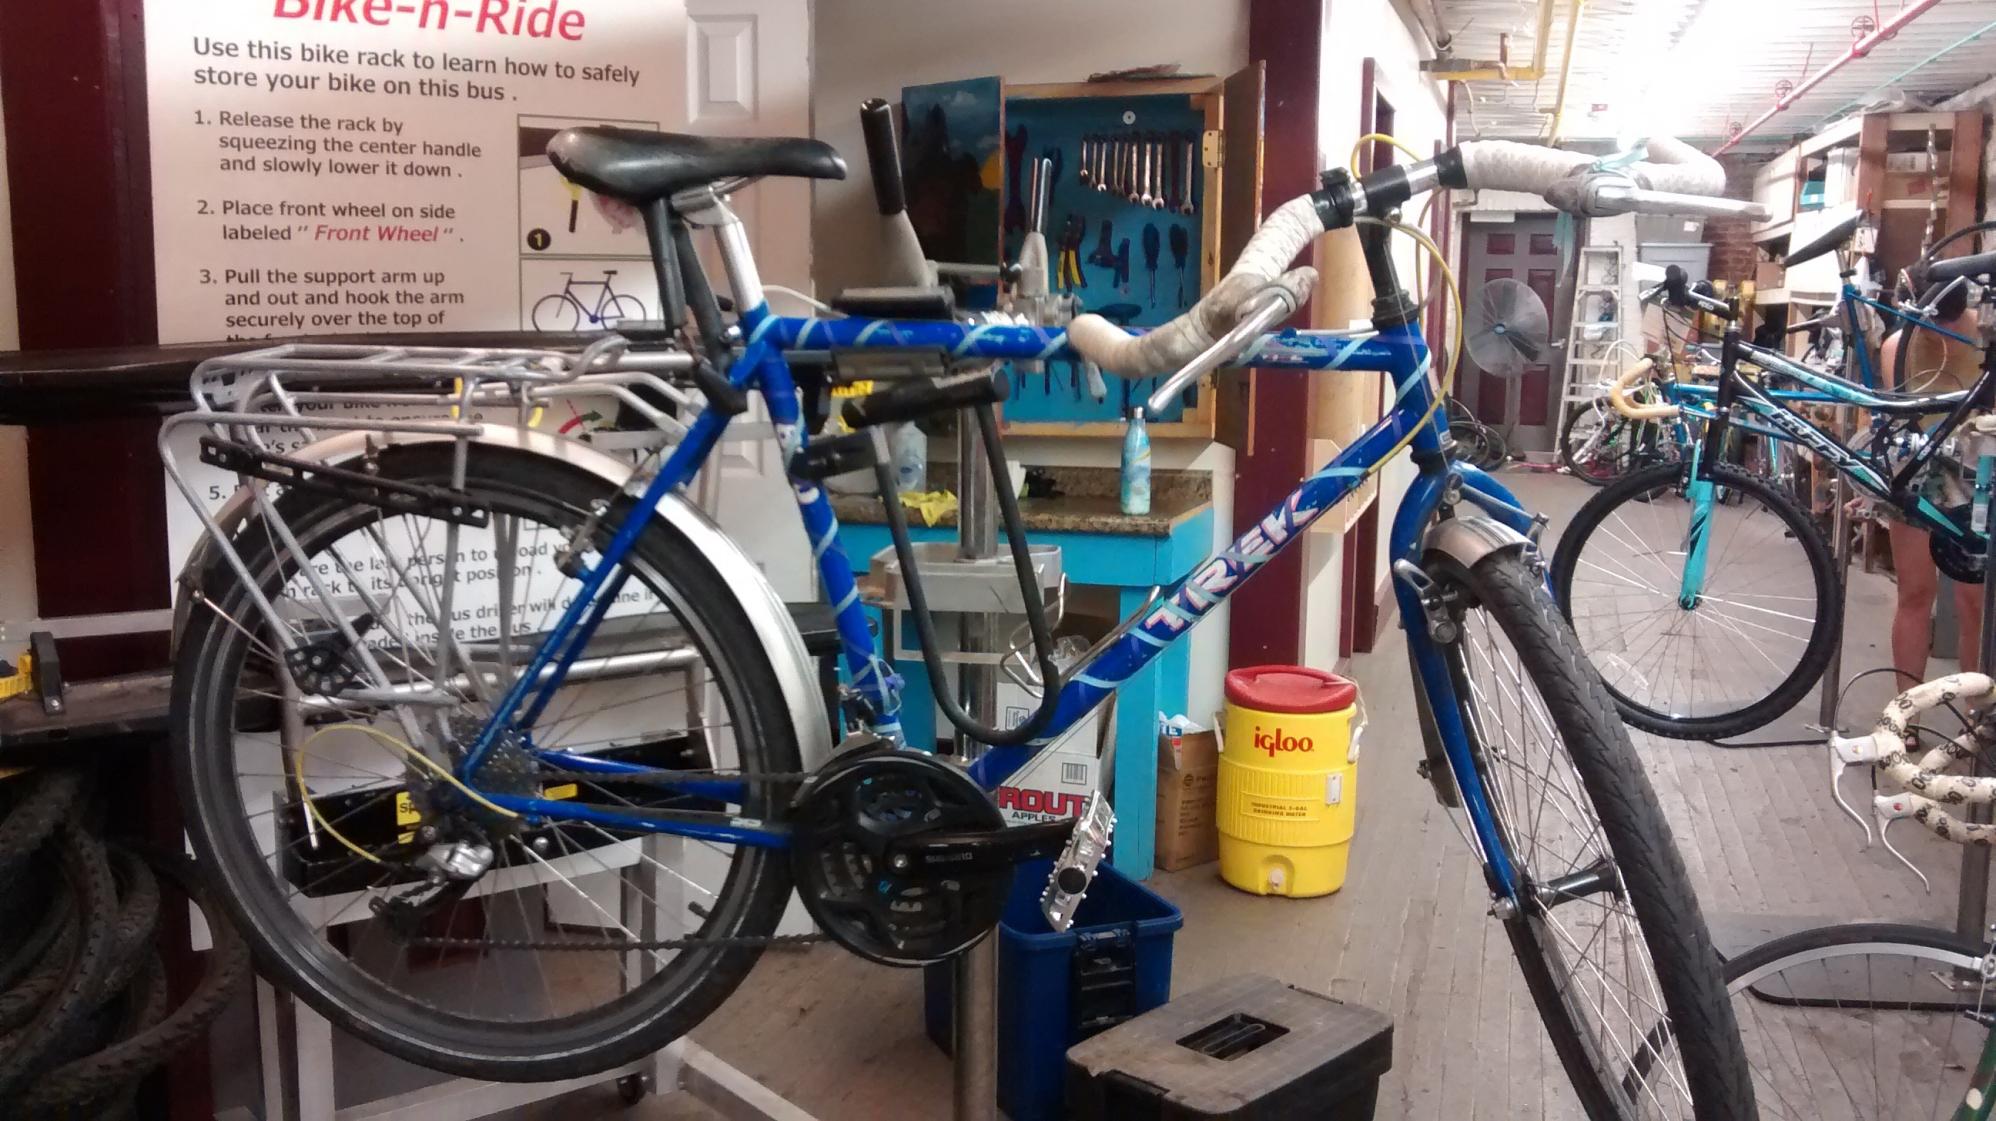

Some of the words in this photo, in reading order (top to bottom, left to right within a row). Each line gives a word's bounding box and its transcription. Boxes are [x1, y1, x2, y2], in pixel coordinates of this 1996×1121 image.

[193, 37, 239, 57] Use
[247, 40, 292, 61] this
[301, 43, 349, 64] bike
[357, 49, 405, 68] rack
[413, 51, 435, 70] to
[442, 53, 496, 74] learn
[505, 57, 548, 77] how
[555, 61, 575, 80] to
[582, 64, 640, 87] safely
[194, 66, 258, 87] store
[265, 72, 320, 93] your
[329, 72, 376, 94] bike
[384, 78, 411, 95] on
[419, 78, 459, 98] this
[467, 81, 504, 101] bus
[194, 110, 212, 125] 1.
[220, 111, 294, 129] Release
[300, 113, 331, 130] the
[337, 116, 376, 132] rack
[382, 118, 403, 136] by
[219, 135, 317, 154] squeezing
[323, 137, 354, 153] the
[359, 140, 416, 155] center
[423, 141, 482, 158] handle
[220, 156, 256, 171] and
[263, 157, 322, 176] slowly
[329, 158, 379, 175] lower
[386, 160, 398, 176] it
[403, 160, 451, 177] down
[197, 200, 215, 215] 2.
[222, 200, 273, 216] Place
[280, 200, 326, 217] front
[332, 203, 386, 218] wheel
[391, 206, 414, 218] on
[420, 203, 456, 219] side
[222, 224, 292, 241] labeled
[314, 224, 371, 241] Front
[377, 225, 438, 242] Wheel
[199, 269, 218, 284] 3.
[225, 268, 260, 284] Pull
[267, 269, 297, 284] the
[304, 269, 375, 287] support
[381, 271, 416, 284] arm
[423, 272, 445, 287] up
[225, 290, 261, 306] and
[267, 292, 298, 306] out
[305, 290, 339, 305] and
[345, 290, 390, 305] hook
[395, 290, 425, 304] the
[430, 292, 464, 304] arm
[226, 311, 305, 329] securely
[311, 313, 352, 327] over
[358, 311, 388, 326] the
[393, 311, 422, 328] top
[427, 310, 445, 325] of
[209, 485, 227, 500] 5.
[335, 560, 364, 573] te
[408, 551, 465, 568] persn
[471, 548, 488, 562] to
[1144, 489, 1320, 632] TREK
[304, 580, 342, 597] rak
[371, 577, 392, 590] its
[399, 569, 460, 588] rigt
[467, 564, 532, 584] poson
[476, 602, 527, 619] drier
[529, 597, 556, 613] will
[415, 627, 465, 643] inse
[470, 625, 497, 639] the
[1254, 726, 1313, 757] igloo
[1011, 811, 1057, 823] APPLES
